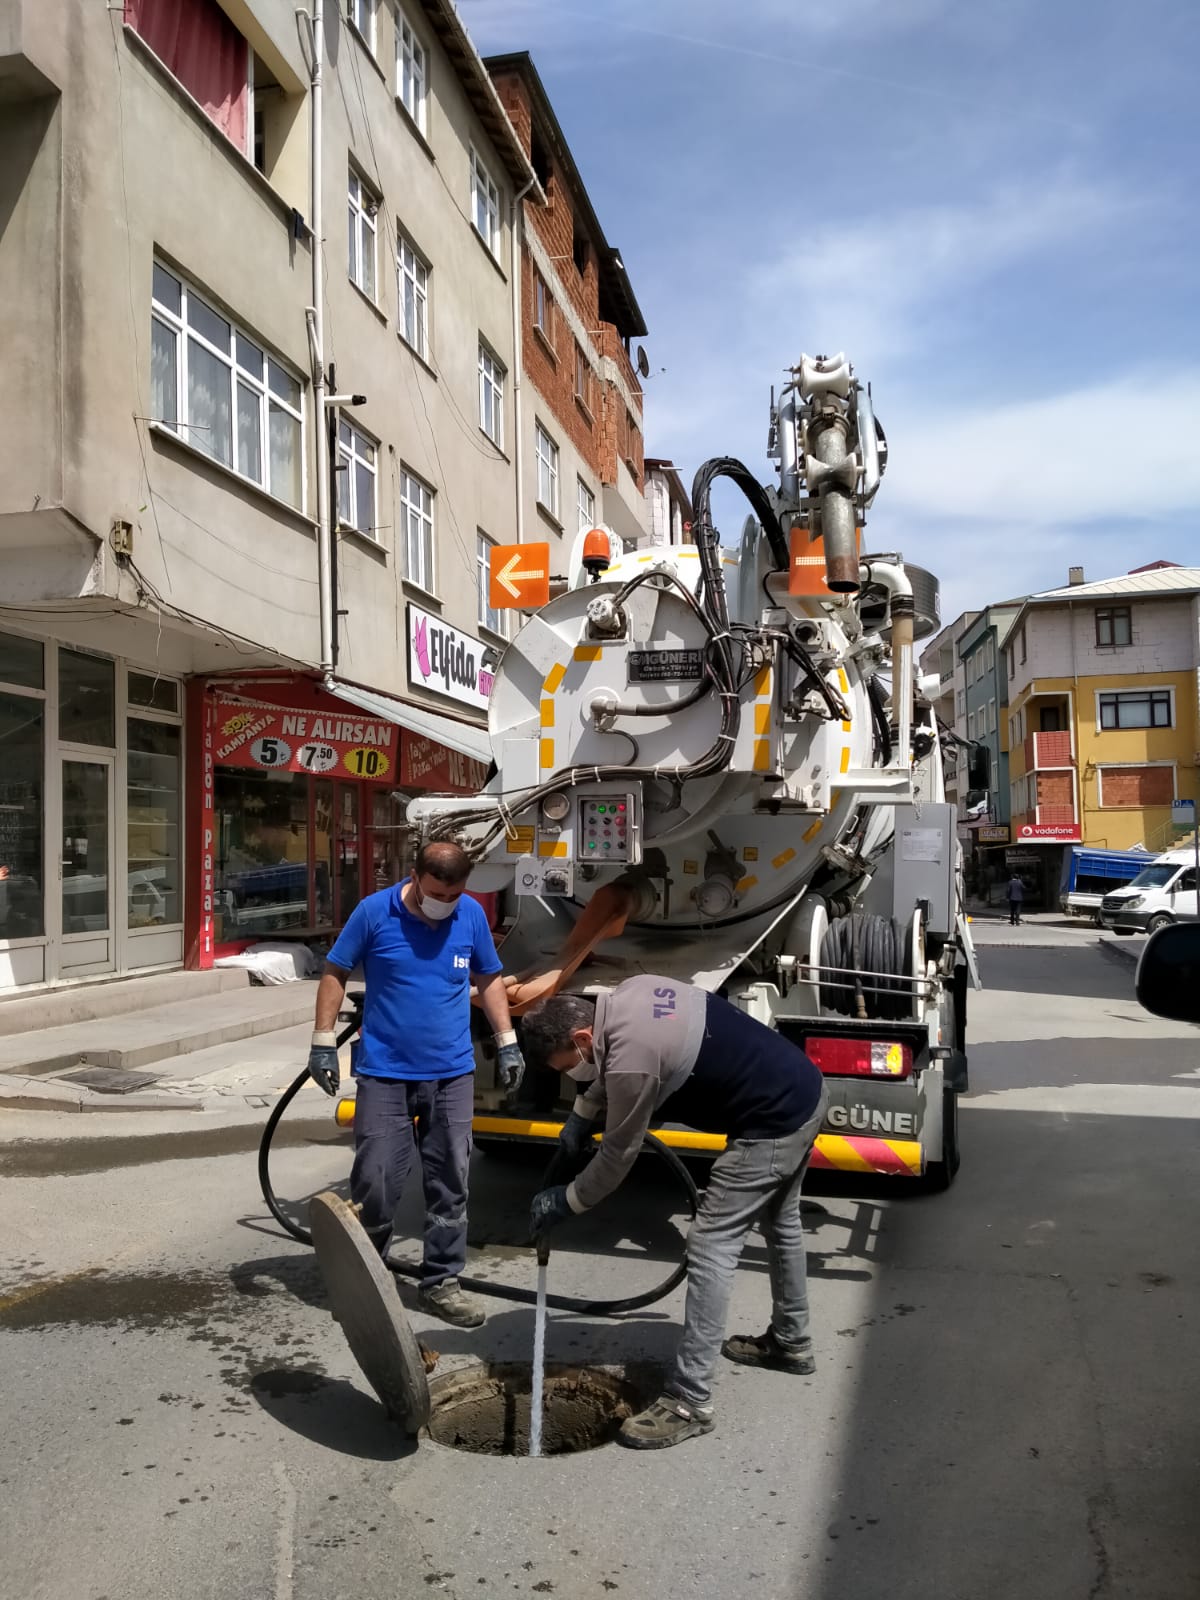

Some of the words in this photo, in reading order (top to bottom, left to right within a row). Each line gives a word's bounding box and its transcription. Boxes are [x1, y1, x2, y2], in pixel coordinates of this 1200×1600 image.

[430, 628, 477, 691] Elfida
[216, 714, 277, 759] KAMPANYA
[282, 715, 306, 737] NE
[311, 718, 392, 746] ALIRSAN
[260, 739, 278, 764] 5
[305, 746, 333, 767] 7.50
[355, 750, 378, 774] 10
[448, 751, 466, 787] NE
[1035, 827, 1073, 835] vodafone
[653, 987, 677, 1019] TLS
[827, 1103, 917, 1135] GÜNE
